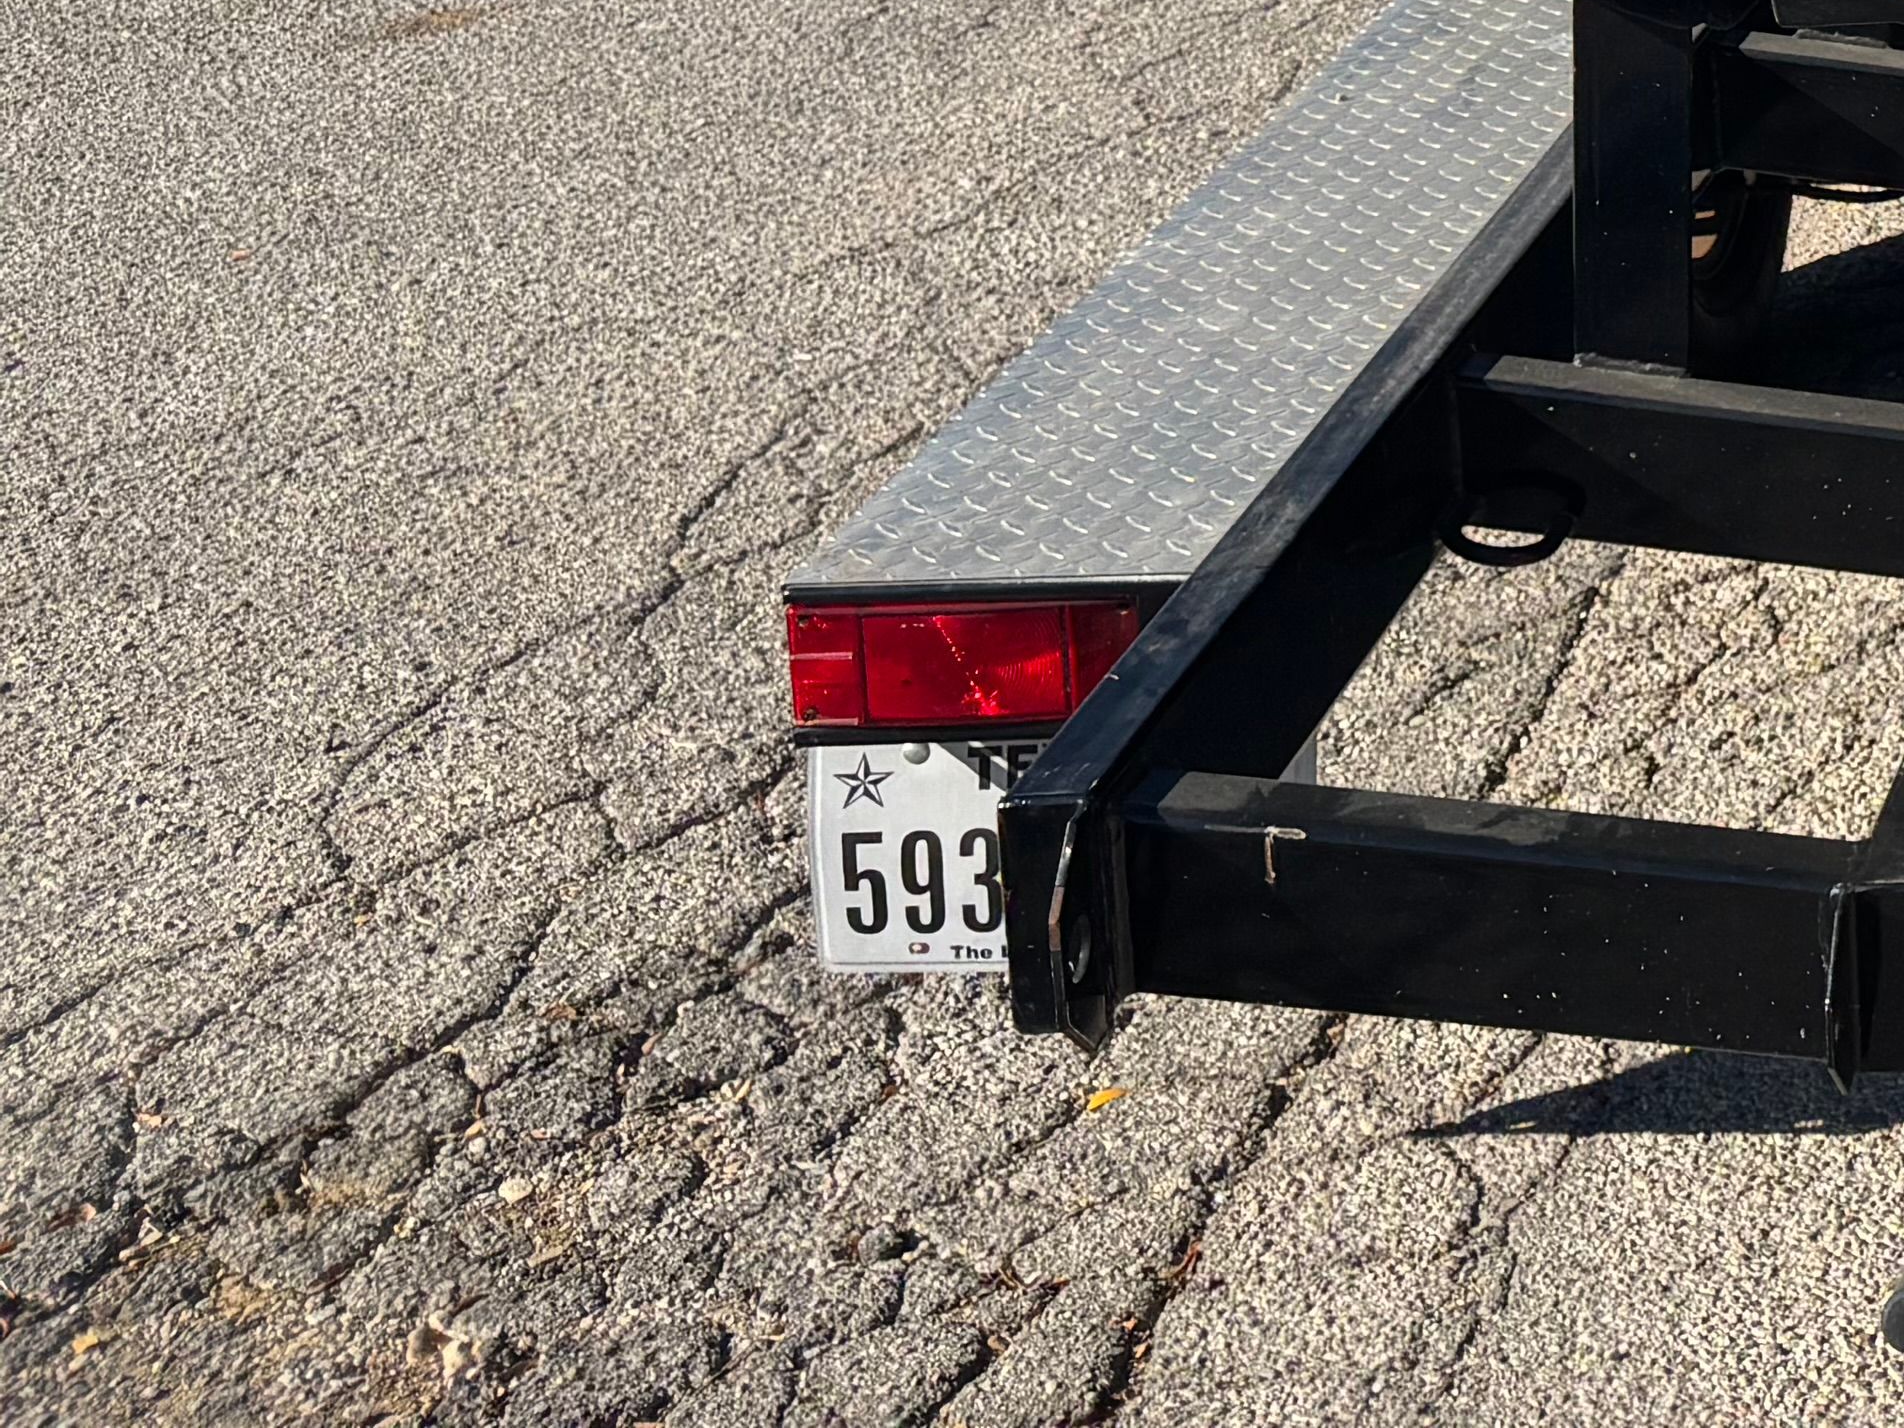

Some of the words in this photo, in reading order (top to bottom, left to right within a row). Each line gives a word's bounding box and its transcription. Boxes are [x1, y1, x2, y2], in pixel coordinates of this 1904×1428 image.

[967, 744, 1048, 793] TE
[841, 827, 1003, 934] 593
[949, 945, 993, 959] The
